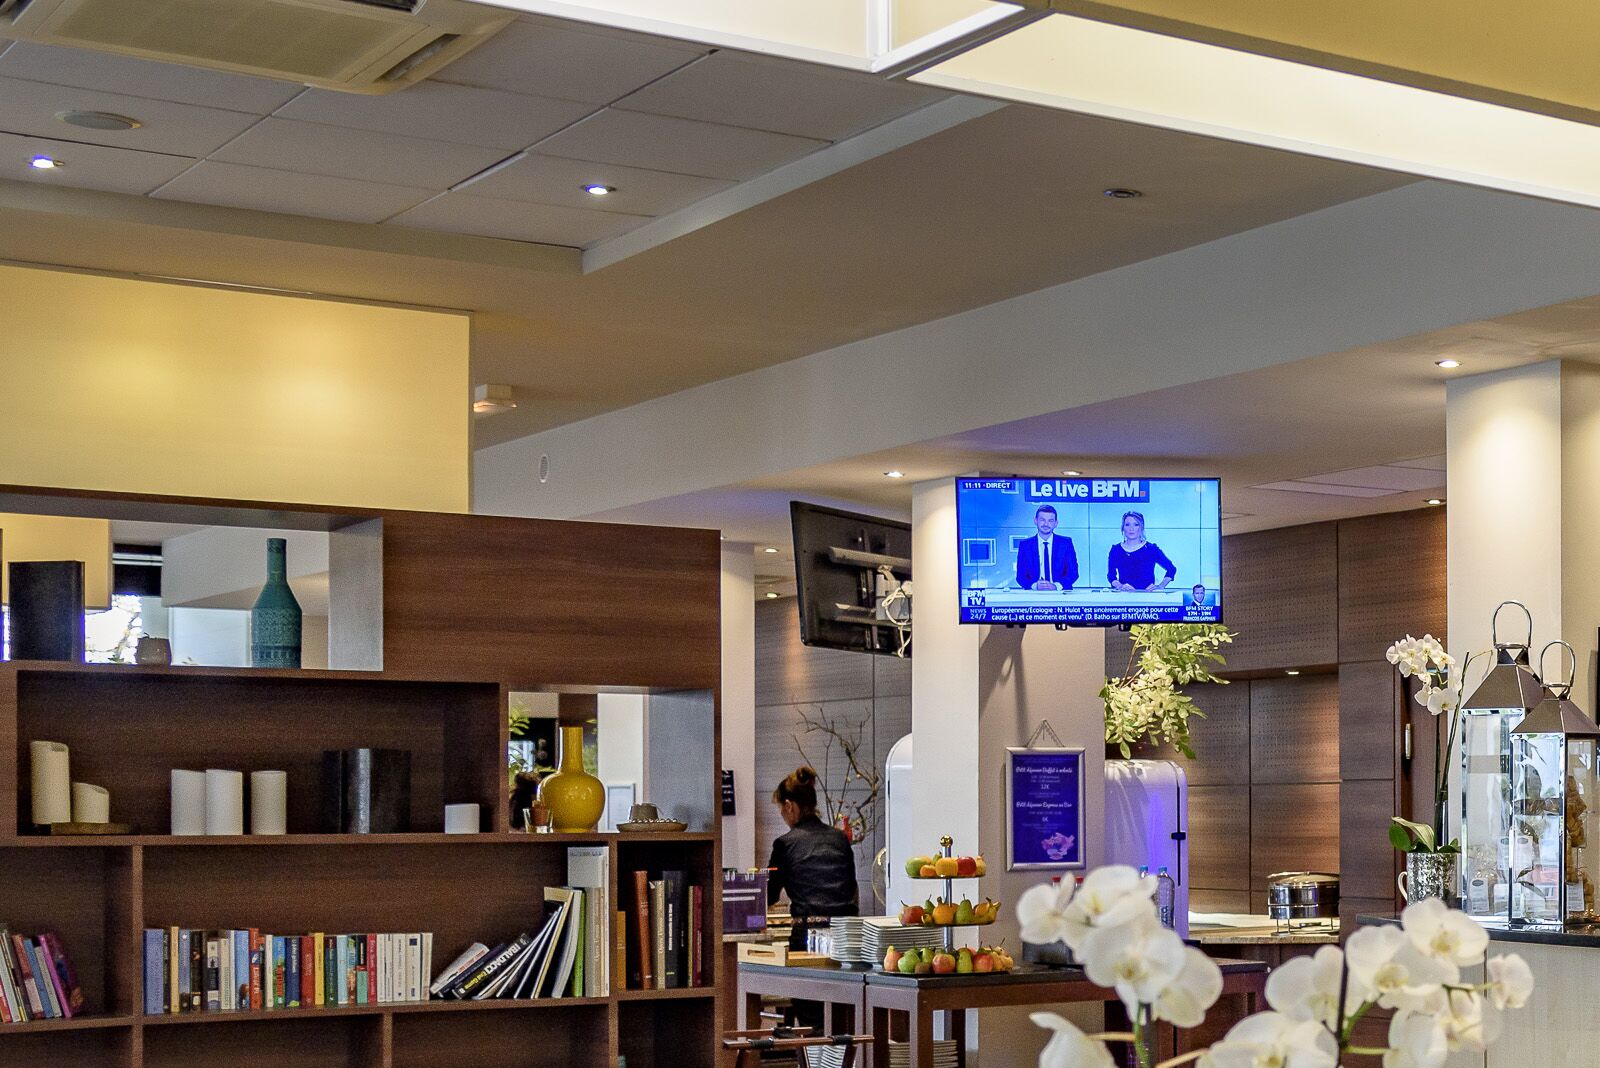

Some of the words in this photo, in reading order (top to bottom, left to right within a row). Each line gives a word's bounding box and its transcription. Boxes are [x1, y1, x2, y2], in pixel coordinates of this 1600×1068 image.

[1030, 480, 1052, 497] Le
[1055, 480, 1089, 497] live
[967, 589, 985, 597] BFM
[970, 613, 987, 621] 24/7
[1094, 613, 1111, 621] Batho
